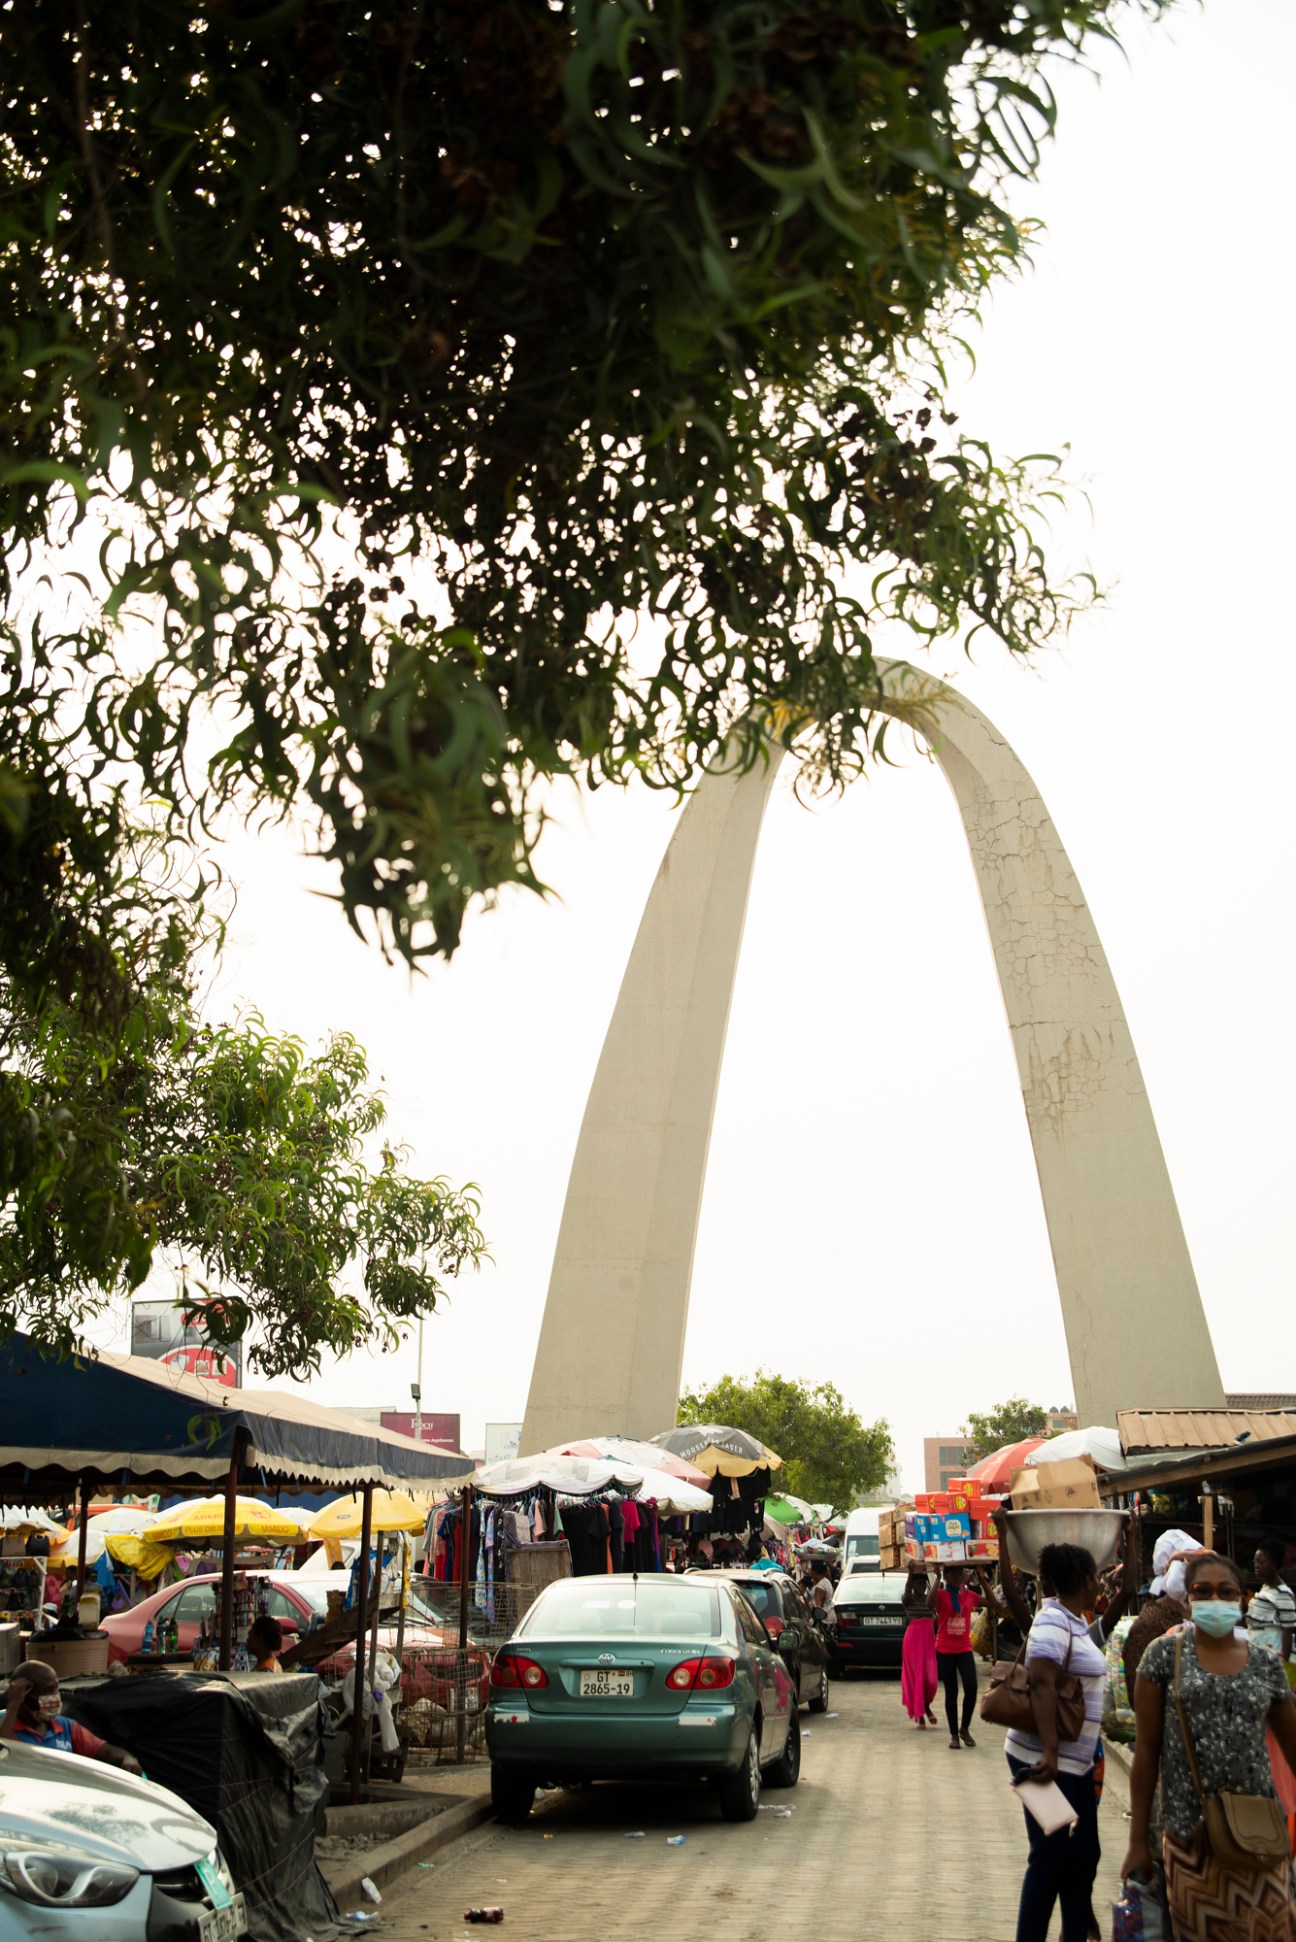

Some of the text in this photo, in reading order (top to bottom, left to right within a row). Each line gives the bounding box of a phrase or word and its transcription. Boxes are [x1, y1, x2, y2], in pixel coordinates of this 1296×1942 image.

[720, 1440, 744, 1455] LAGER
[185, 1524, 203, 1533] PLUS
[596, 1671, 611, 1683] GT
[583, 1683, 630, 1695] 2865-19
